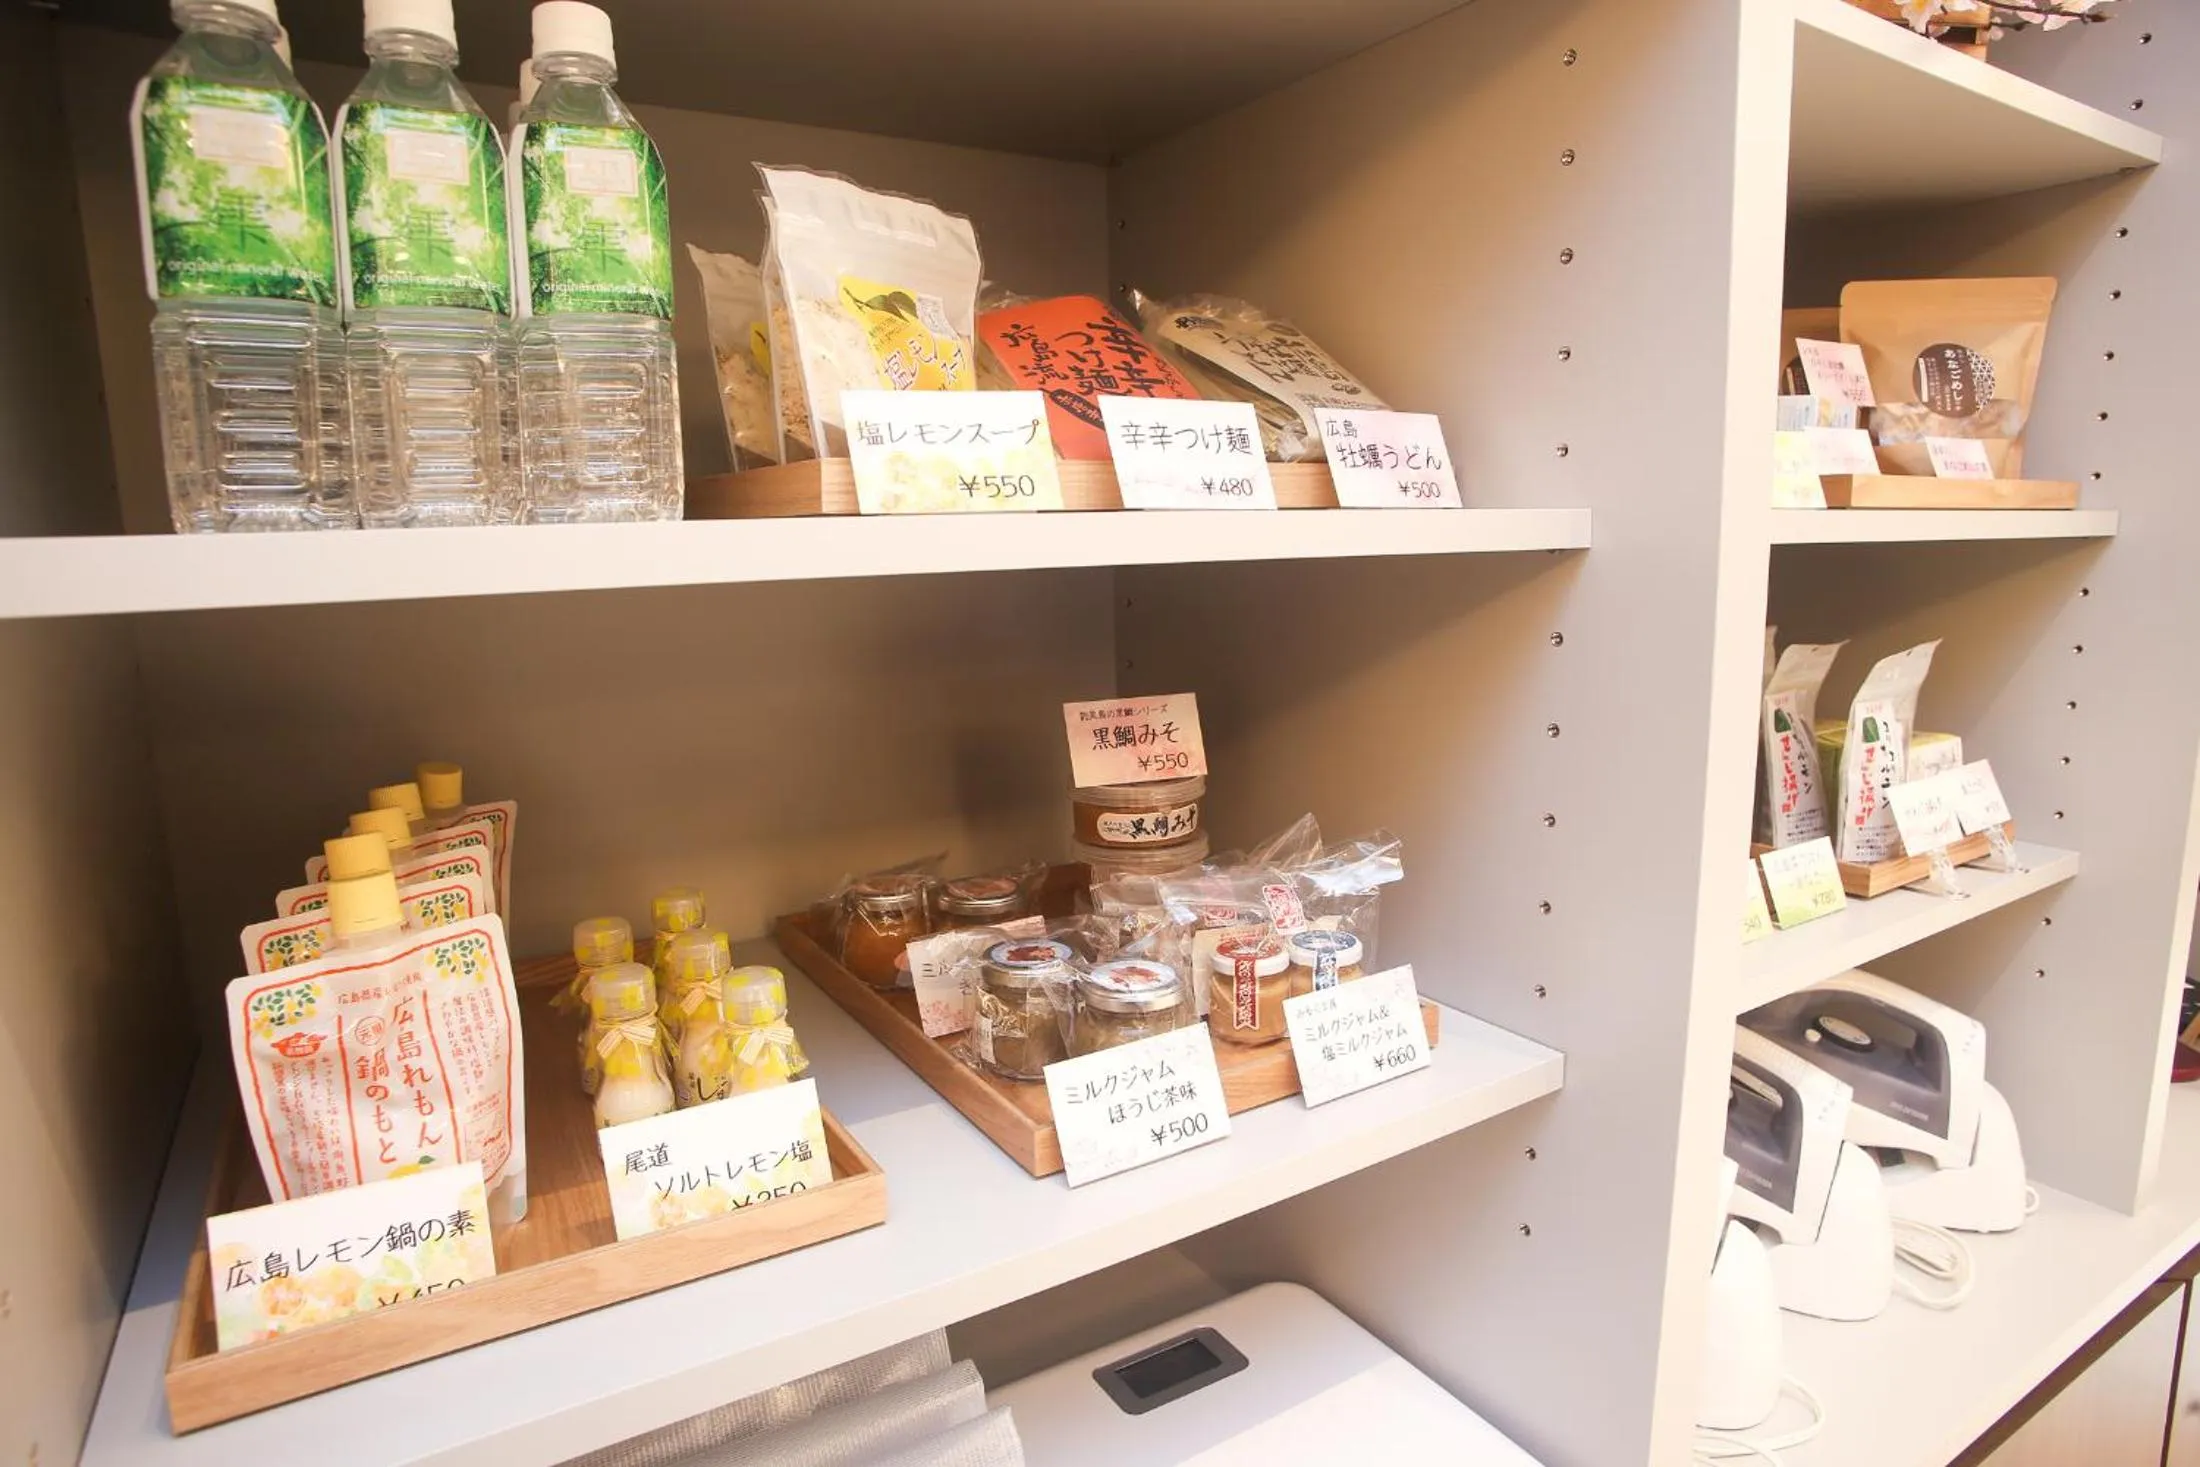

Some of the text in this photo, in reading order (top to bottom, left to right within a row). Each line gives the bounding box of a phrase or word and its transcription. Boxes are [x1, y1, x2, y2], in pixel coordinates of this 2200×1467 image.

[857, 418, 1040, 446] 塩レモンスープ
[1120, 420, 1254, 455] 辛辛つけ麺
[1326, 416, 1358, 438] 広島
[1335, 442, 1443, 470] 牡蠣うどん
[958, 474, 1036, 499] ¥550
[1201, 476, 1254, 497] ¥480
[1397, 480, 1442, 498] ¥500
[1092, 720, 1181, 751] 黒鯛みそ
[1137, 751, 1190, 773] ¥550
[1322, 1021, 1409, 1062] 塩ミルクジャム
[1373, 1043, 1417, 1072] ¥660
[392, 995, 444, 1149] 広島れもん
[1064, 1058, 1176, 1105] ミルクジャム
[354, 1046, 398, 1165] 鍋のもと
[1108, 1079, 1198, 1125] ほうじ茶味
[1150, 1111, 1209, 1147] ¥500
[624, 1142, 672, 1177] 尾道
[654, 1138, 813, 1201] ソルトレモン塩
[224, 1208, 476, 1293] 広島レモン鍋の素
